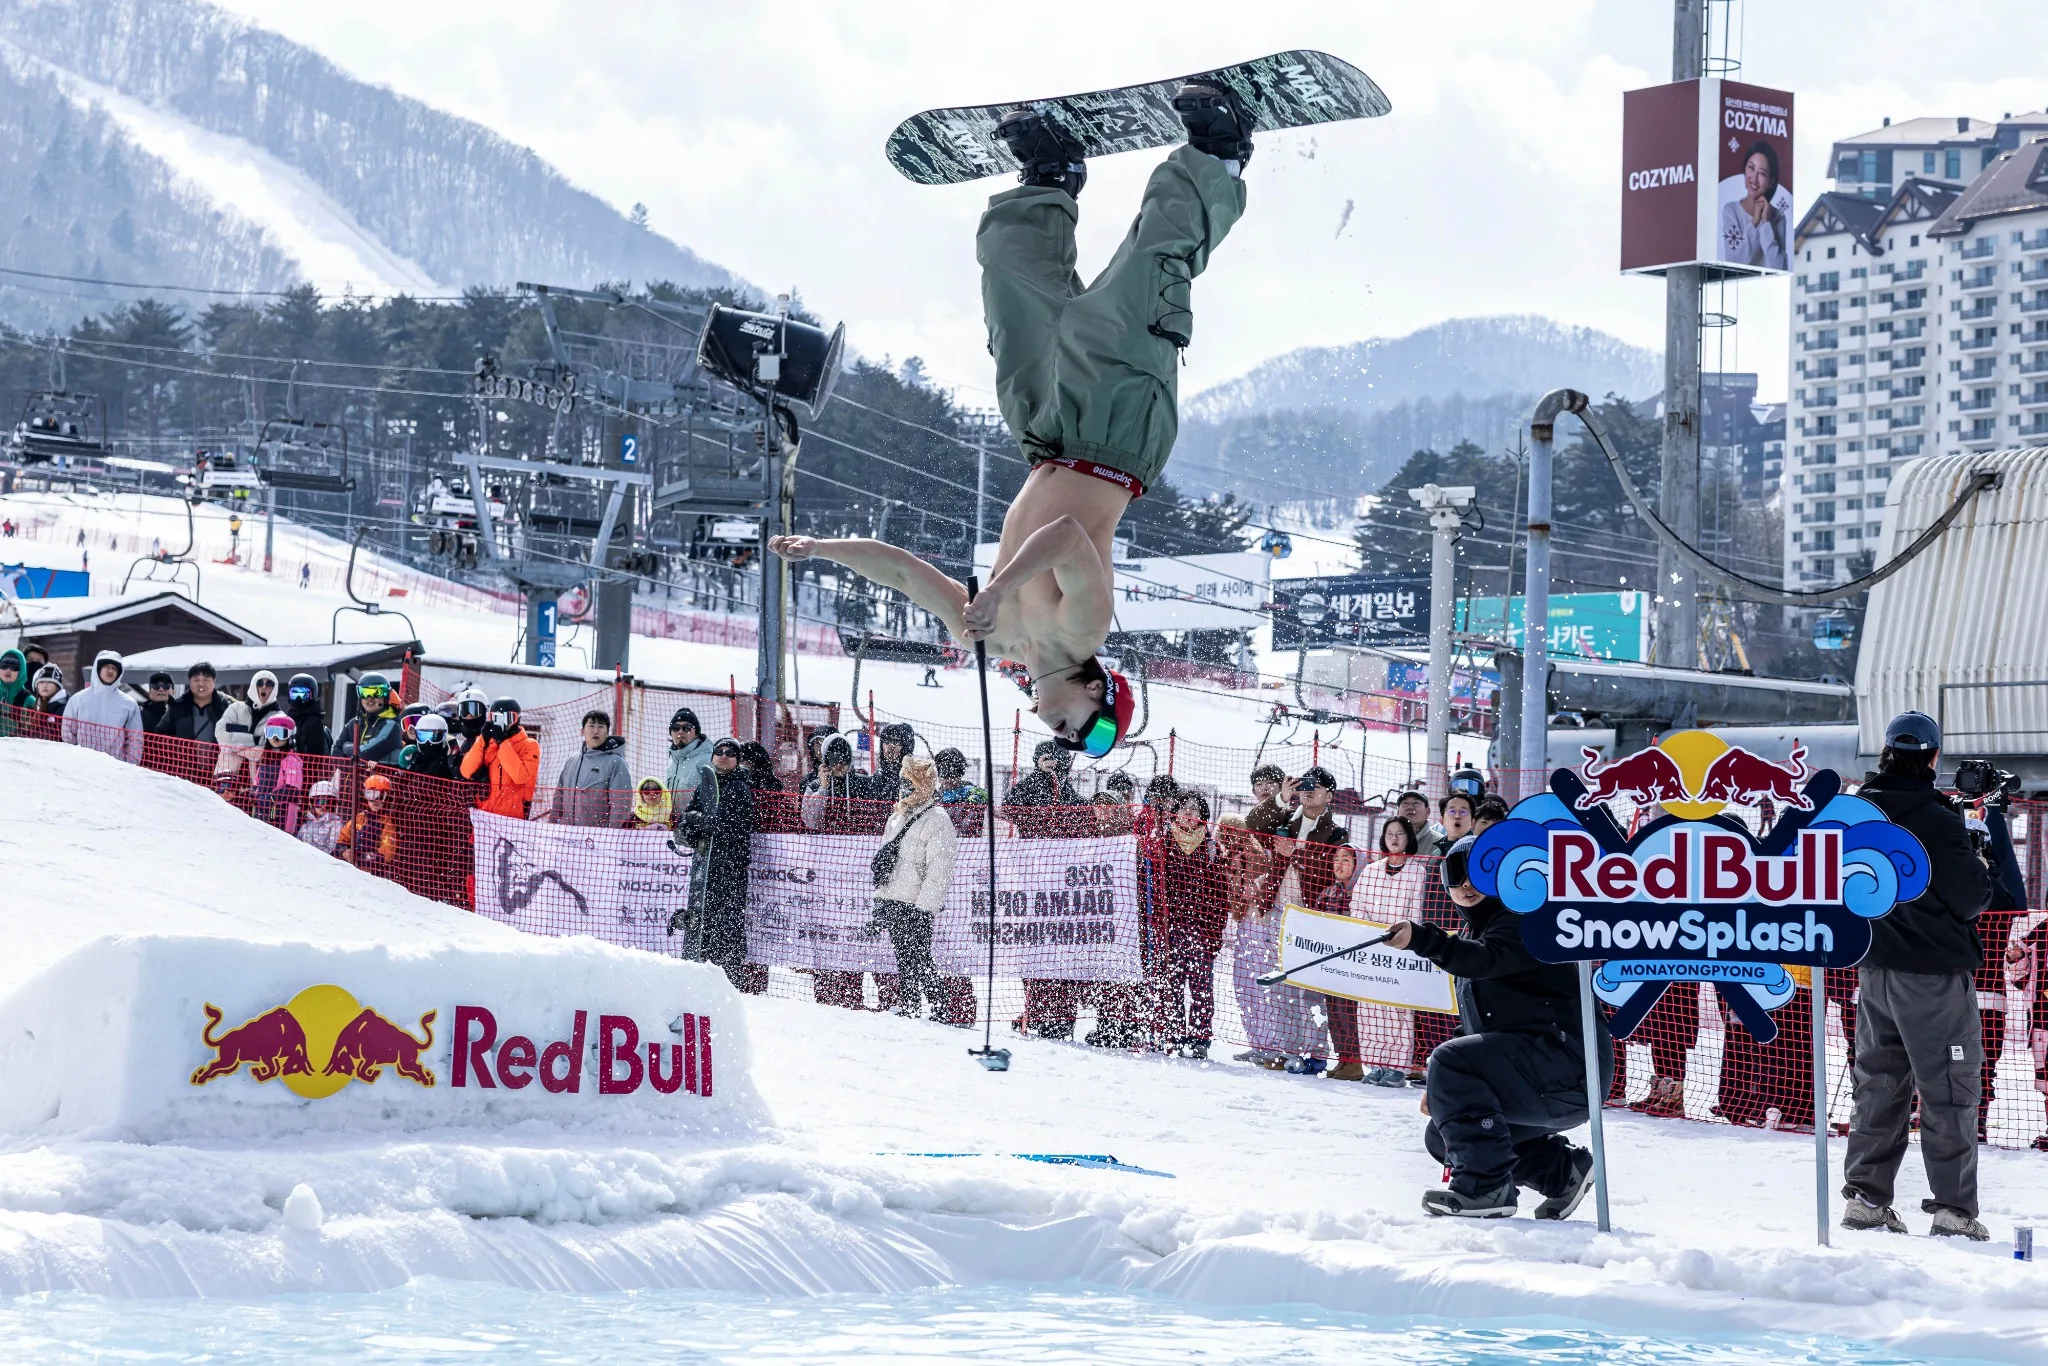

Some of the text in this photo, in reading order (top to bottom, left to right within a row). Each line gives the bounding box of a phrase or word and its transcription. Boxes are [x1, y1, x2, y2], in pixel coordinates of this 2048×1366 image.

[1725, 110, 1787, 137] COZYMA
[1629, 164, 1694, 190] COZYMA
[624, 438, 635, 460] 2
[1093, 465, 1132, 488] Supreme
[1196, 582, 1217, 598] 미래
[1222, 580, 1254, 597] 사이에
[1330, 591, 1415, 620] 세계일보
[544, 606, 555, 633] 1
[1554, 834, 1837, 900] Red Bull
[1556, 909, 1833, 957] SnowSplash
[1295, 935, 1334, 955] 마피아의
[1370, 952, 1392, 968] 심장
[1395, 957, 1432, 973] 신교대
[1320, 964, 1349, 978] Fearless
[1375, 976, 1400, 986] MAFIA
[1621, 964, 1765, 978] MONAYONGPYONG
[452, 1006, 712, 1097] Red Bull
